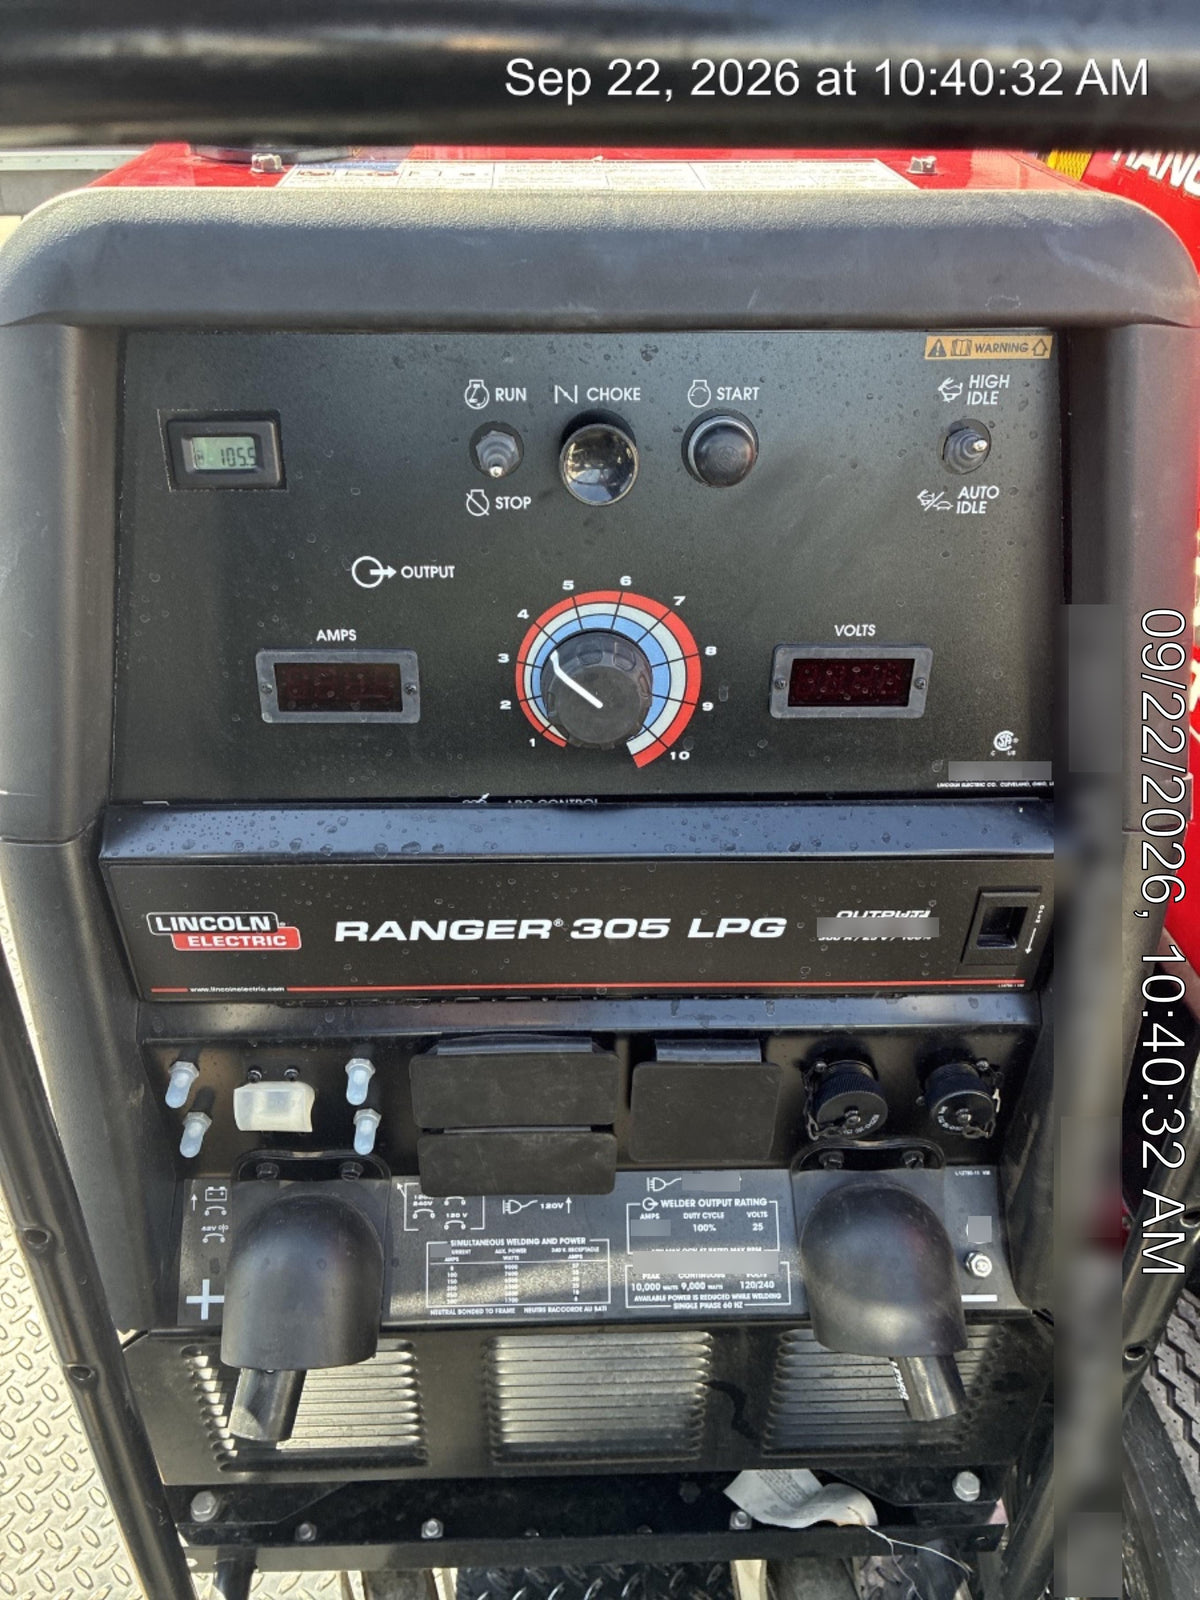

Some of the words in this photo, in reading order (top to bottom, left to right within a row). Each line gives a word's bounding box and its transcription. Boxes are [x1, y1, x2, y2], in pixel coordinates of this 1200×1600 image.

[974, 342, 1029, 353] WARNING
[968, 374, 1011, 389] HIGH
[494, 387, 527, 401] RUN
[586, 387, 641, 401] CHOKE
[716, 387, 760, 401] START
[966, 391, 1000, 405] IDLE
[957, 485, 1000, 500] AUTO
[494, 496, 532, 510] STOP
[955, 501, 988, 514] IDLE
[401, 565, 455, 579] OUTPUT
[562, 579, 575, 590] 5
[620, 575, 632, 586] 6
[673, 596, 686, 606] 7
[517, 608, 530, 619] 4
[316, 629, 357, 642] AMPS
[834, 624, 876, 637] VOLTS
[705, 646, 717, 656] 8
[497, 653, 510, 663] 3
[499, 700, 512, 710] 2
[702, 701, 714, 712] 9
[529, 738, 536, 747] 1
[670, 751, 690, 760] 10
[155, 916, 271, 932] LINCOLN
[570, 918, 671, 939] 305
[687, 917, 788, 939] LPG
[187, 935, 287, 947] ELECTRIC
[190, 985, 285, 993] www.lincolnelectric.com
[660, 1199, 696, 1208] WELDER
[698, 1199, 732, 1208] OUTPUT
[734, 1198, 768, 1207] RATING
[640, 1212, 660, 1220] AMPS
[683, 1212, 701, 1220] DUTY
[692, 1223, 717, 1232] 100%
[752, 1222, 764, 1231] 25
[450, 1239, 505, 1247] SIMULTANEOUS
[505, 1238, 540, 1246] WELDING
[559, 1237, 586, 1245] POWER
[631, 1283, 661, 1292] 10,000
[680, 1282, 706, 1292] 9,000
[739, 1280, 775, 1290] 120/240
[634, 1294, 667, 1302] AVAILABLE
[700, 1293, 730, 1301] REDUCED
[751, 1292, 782, 1300] WELDING
[673, 1302, 698, 1310] SINGLE
[430, 1308, 457, 1316] NEUTRAL
